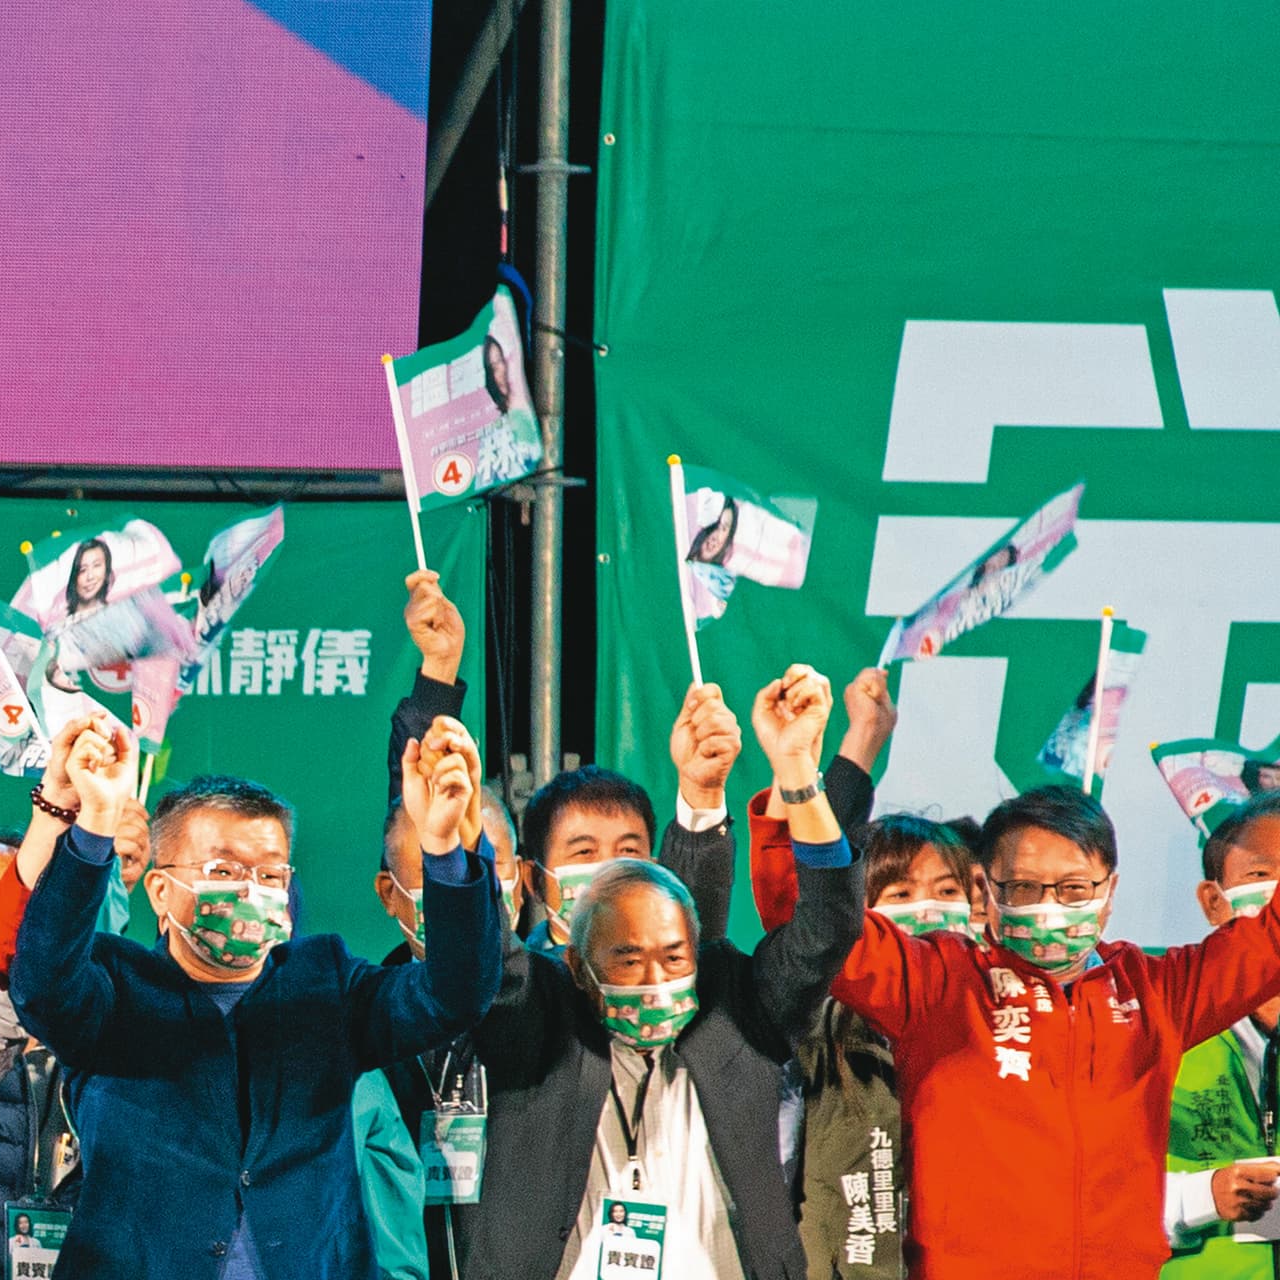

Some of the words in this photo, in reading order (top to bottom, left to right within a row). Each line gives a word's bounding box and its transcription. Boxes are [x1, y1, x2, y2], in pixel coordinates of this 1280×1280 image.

[442, 460, 462, 485] 4
[2, 704, 24, 725] 4
[869, 1126, 897, 1234] 九德里里長
[840, 1171, 877, 1266] 陳美香
[607, 1250, 656, 1271] 貴賓證
